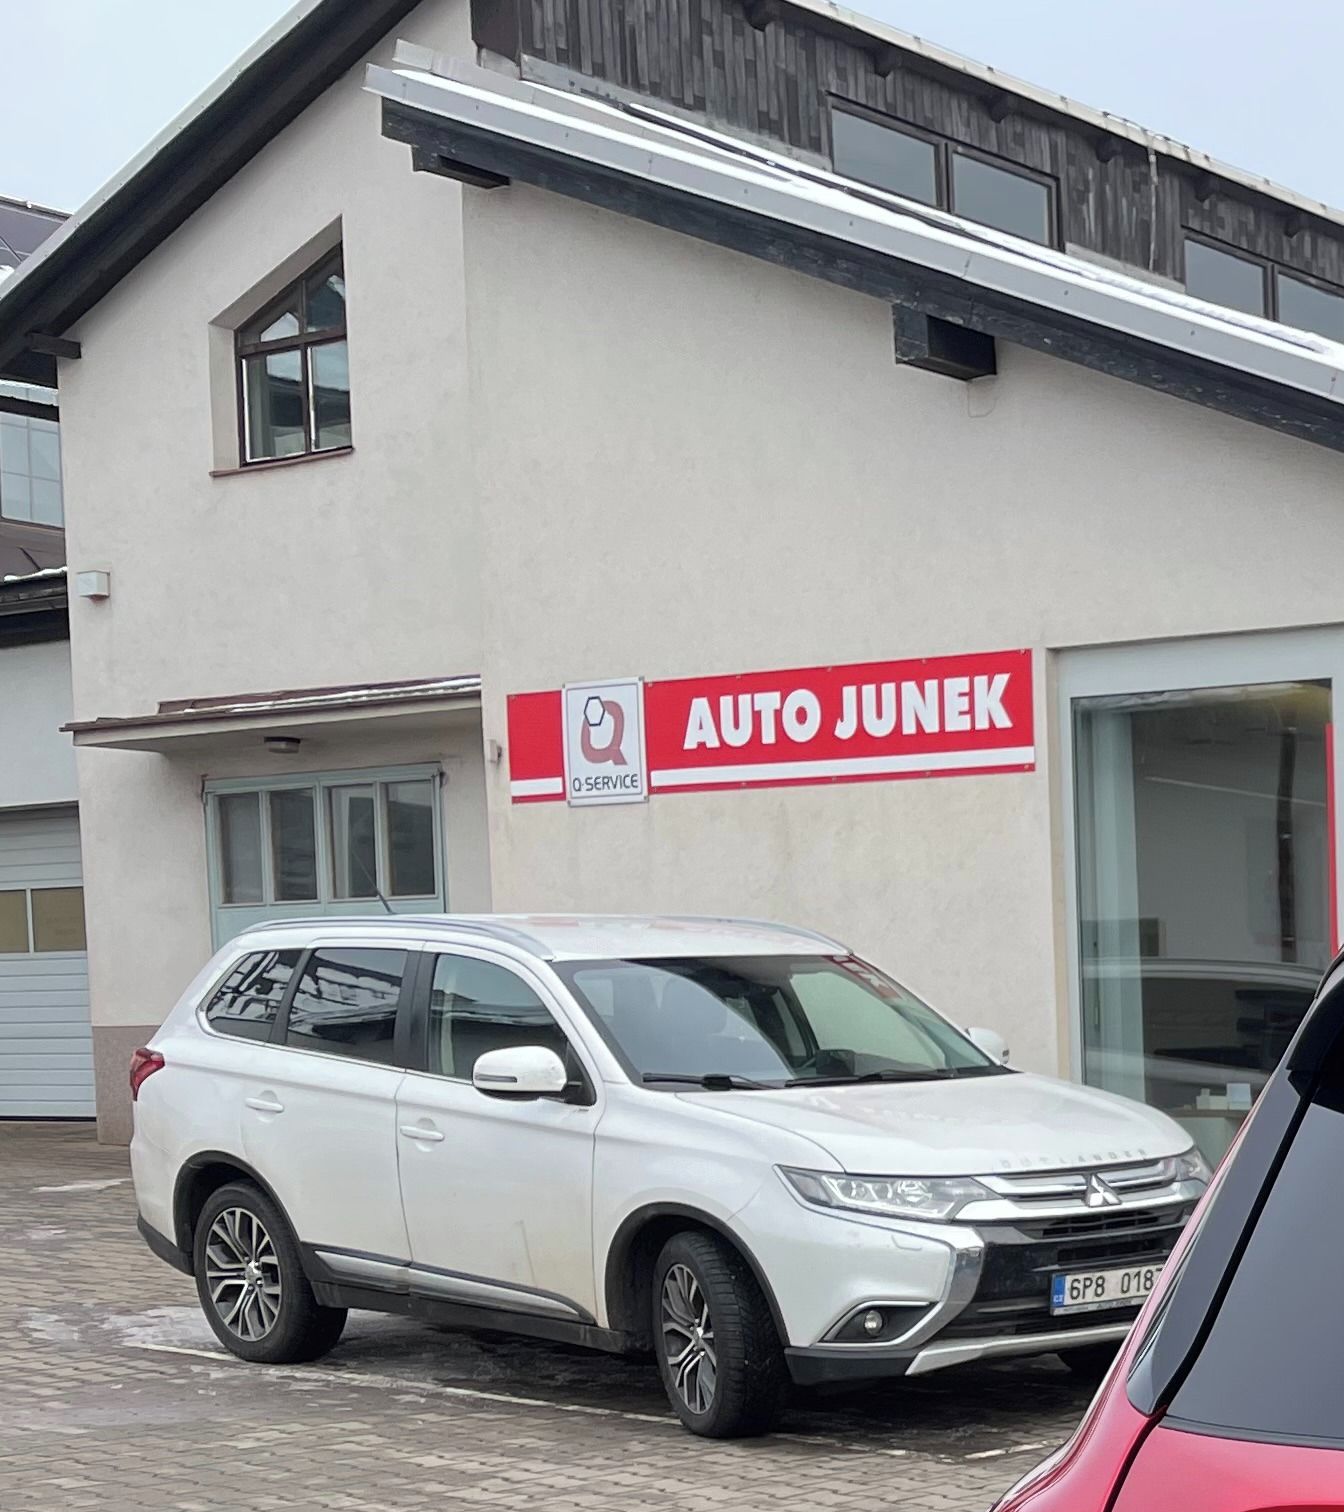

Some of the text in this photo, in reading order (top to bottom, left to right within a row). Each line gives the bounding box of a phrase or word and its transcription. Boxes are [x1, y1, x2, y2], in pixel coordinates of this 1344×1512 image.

[682, 672, 1014, 750] AUTO JUNEK
[1000, 1148, 1148, 1169] OUTLANDER
[1069, 1268, 1162, 1300] 6P8 018
